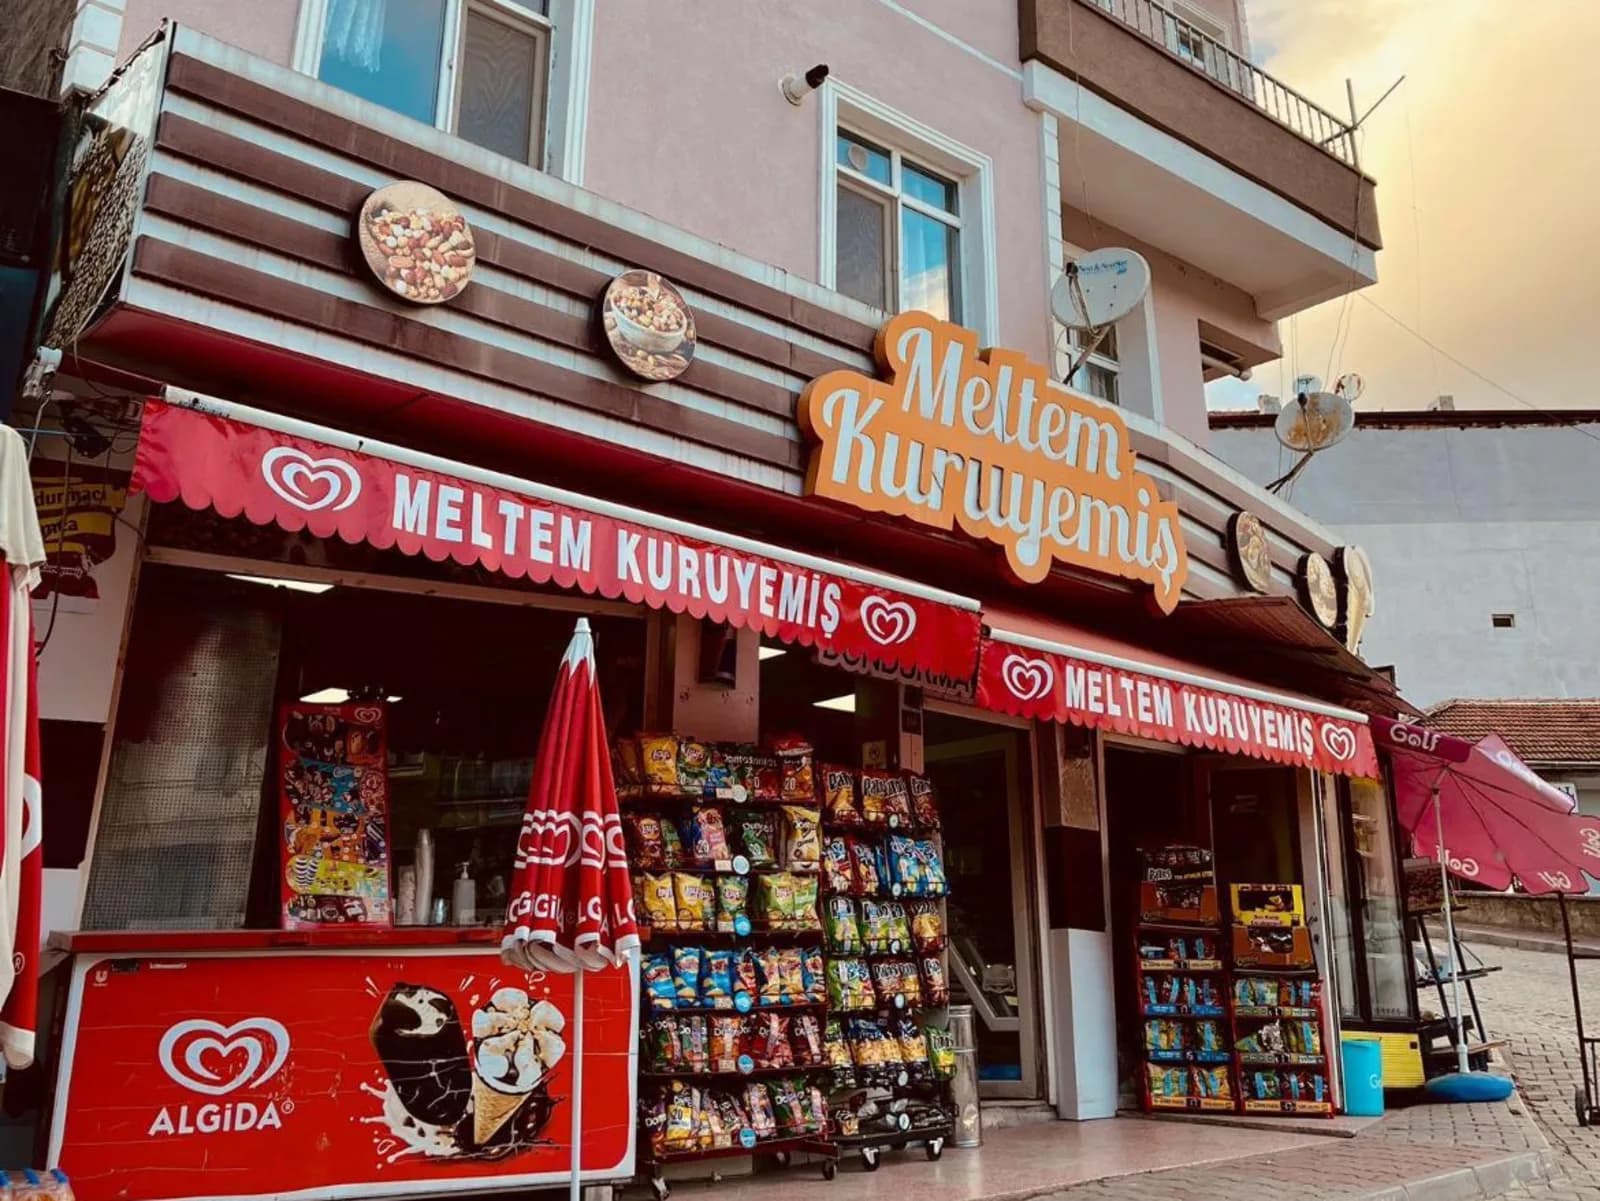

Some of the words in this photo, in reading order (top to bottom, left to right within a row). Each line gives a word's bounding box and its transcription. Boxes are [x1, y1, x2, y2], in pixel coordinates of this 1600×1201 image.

[896, 326, 1121, 480] Meltem
[392, 473, 592, 573] MELTEM
[617, 528, 842, 639] KURUYEMİŞ
[822, 388, 1179, 596] Kuruyemiş
[1065, 664, 1174, 728] MELTEM
[1183, 691, 1314, 761] KURUYEMİŞ
[1389, 723, 1441, 752] Golf
